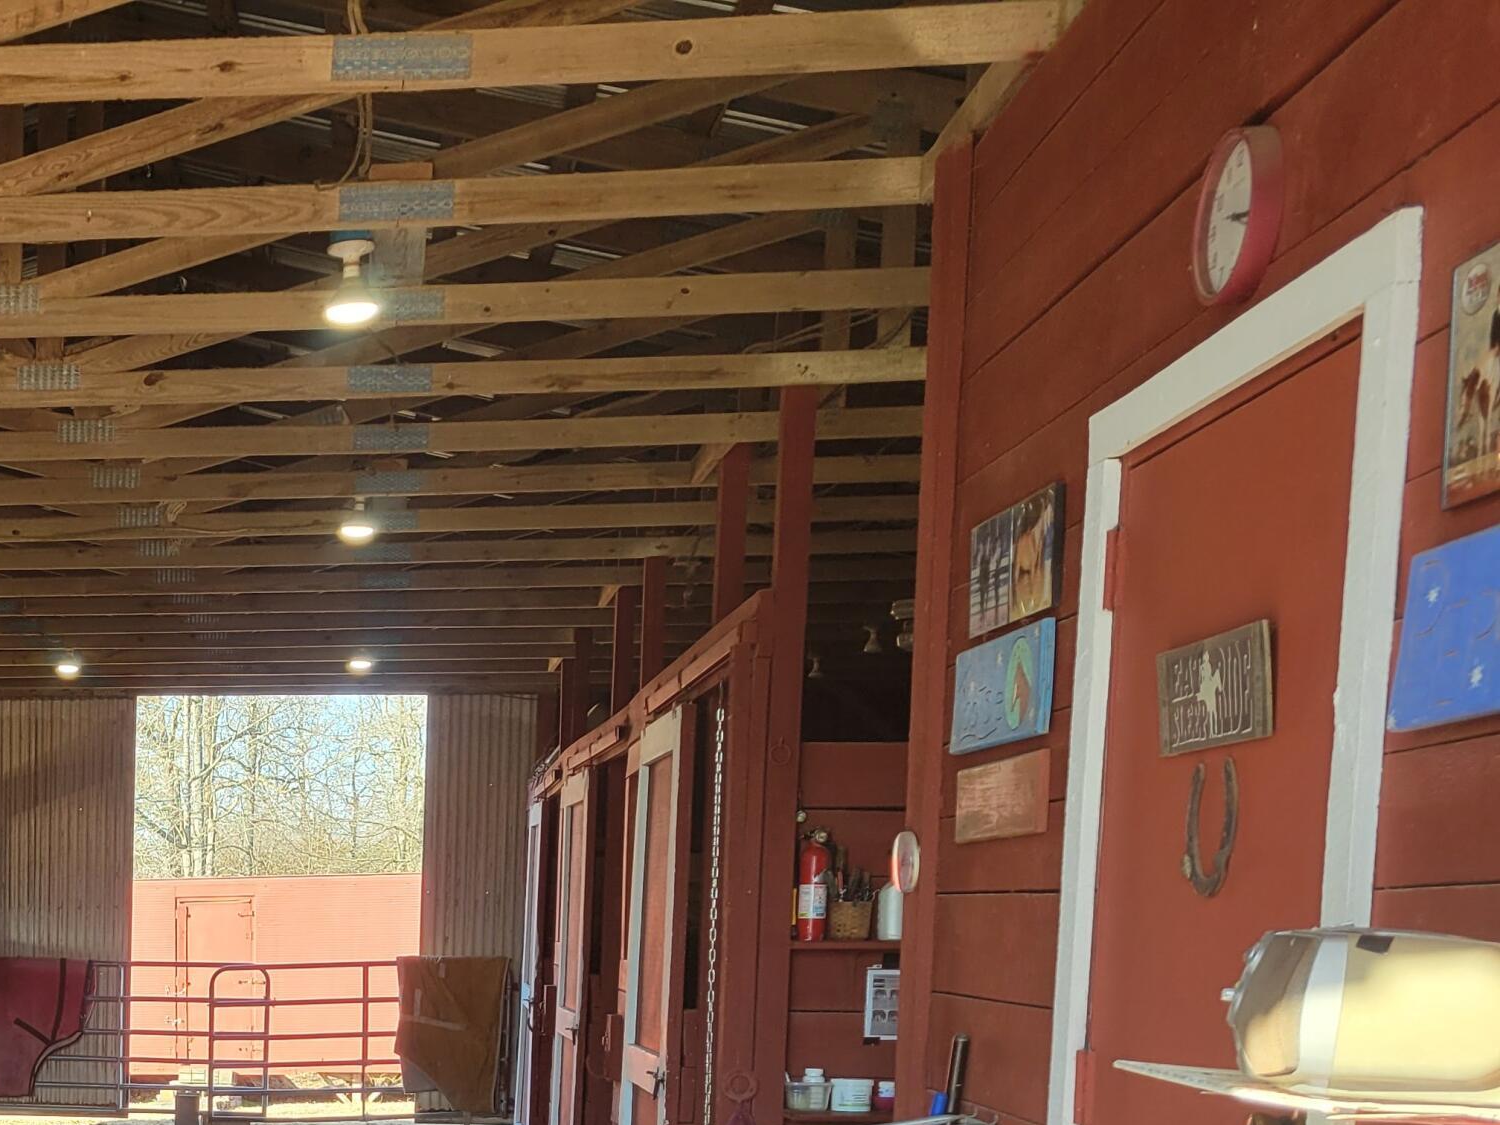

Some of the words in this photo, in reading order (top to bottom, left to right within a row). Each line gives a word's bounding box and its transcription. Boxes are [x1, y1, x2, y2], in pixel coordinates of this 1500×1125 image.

[1171, 655, 1205, 703] EAT
[1209, 638, 1253, 739] RIDE
[1171, 703, 1208, 748] SLEEP
